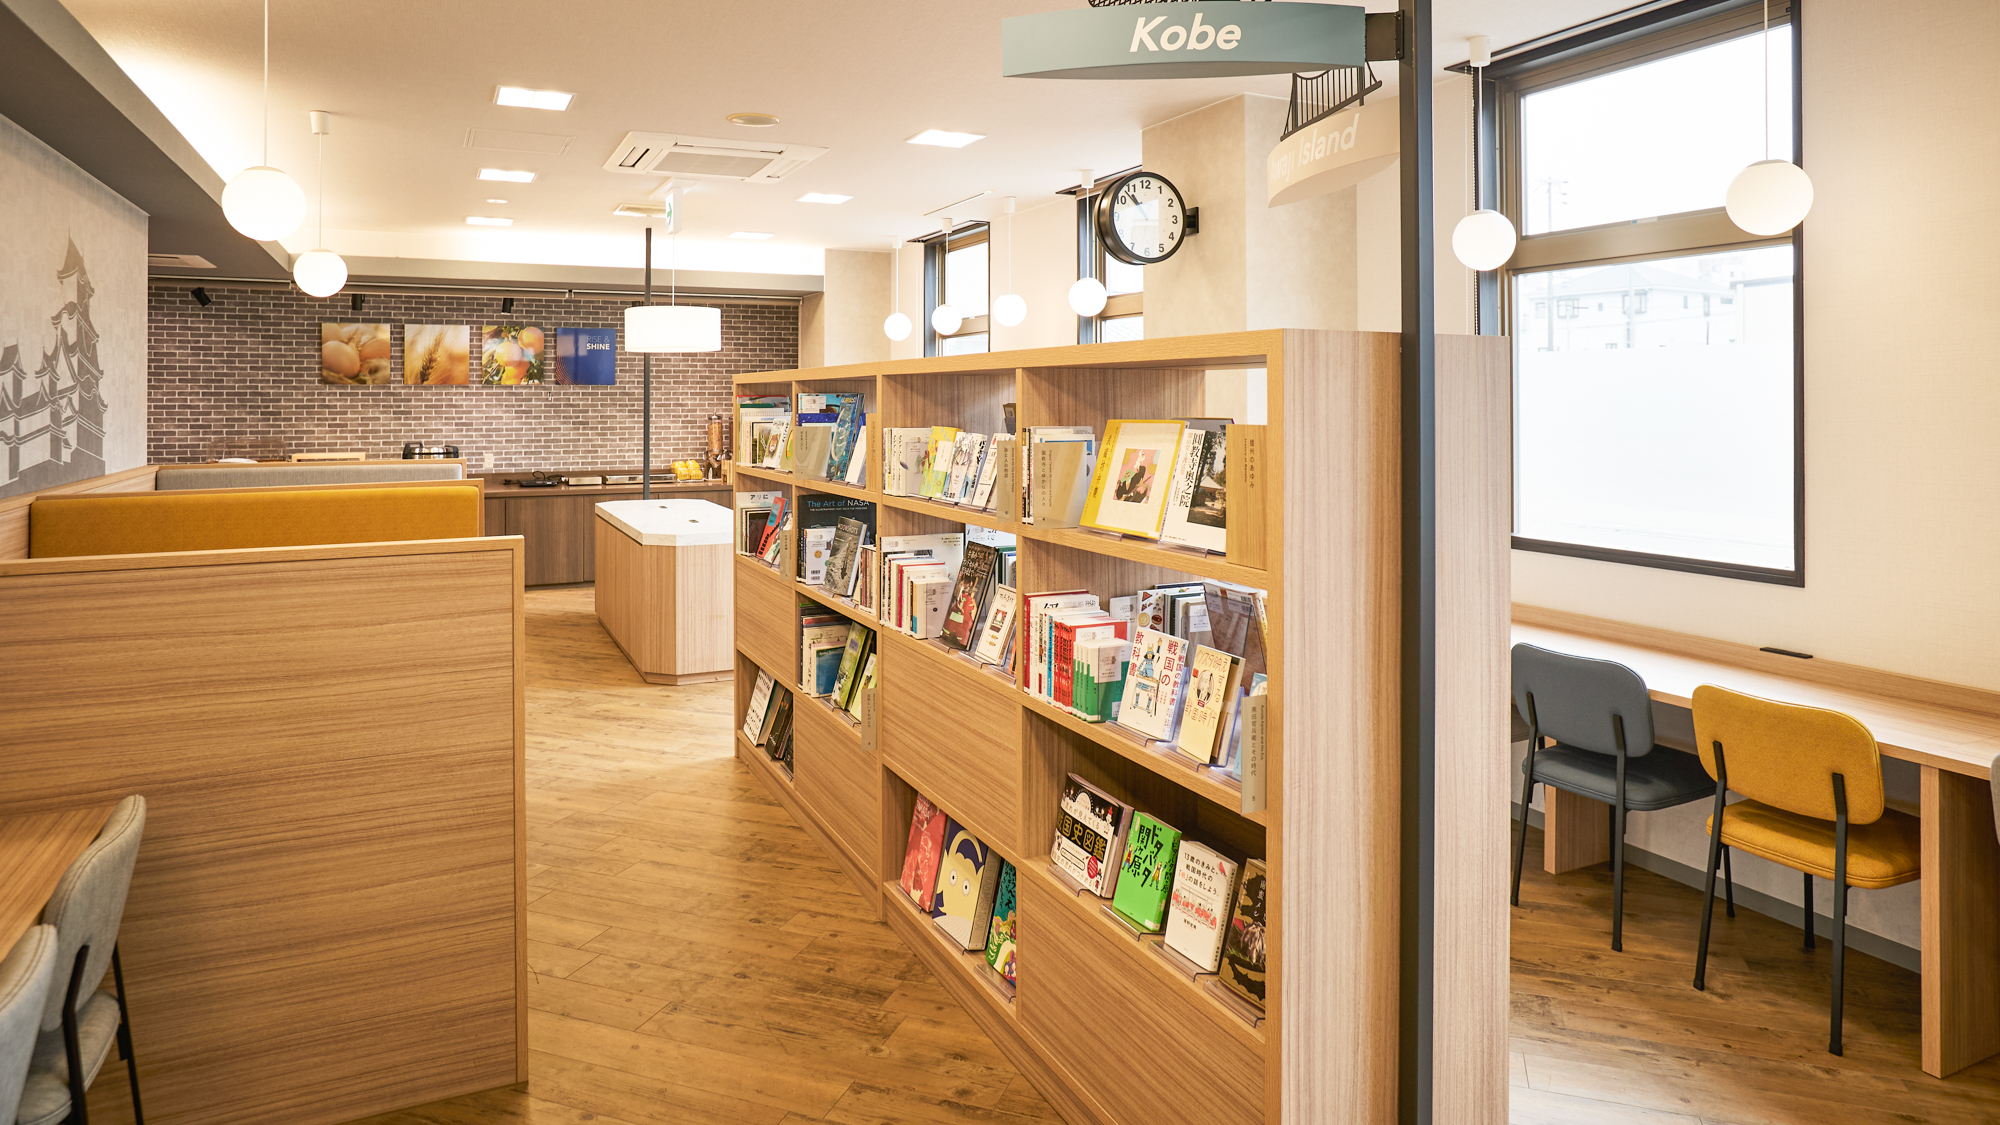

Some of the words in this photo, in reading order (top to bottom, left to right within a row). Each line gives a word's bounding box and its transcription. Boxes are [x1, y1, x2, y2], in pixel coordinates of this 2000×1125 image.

[1130, 12, 1242, 52] Kobe
[1298, 112, 1360, 168] Island
[1126, 183, 1136, 193] 11
[1139, 179, 1151, 190] 12
[1157, 185, 1163, 195] 1
[1116, 195, 1127, 205] 10
[1167, 198, 1174, 208] 2
[1171, 214, 1178, 225] 3
[1168, 231, 1175, 241] 4
[1144, 247, 1150, 257] 6
[1158, 243, 1165, 253] 5
[586, 335, 602, 343] RISE
[1129, 631, 1144, 677] 教科書
[1160, 639, 1178, 686] 戦国の
[1140, 824, 1164, 887] ドタバタ
[1185, 863, 1213, 882] 戦国時代の
